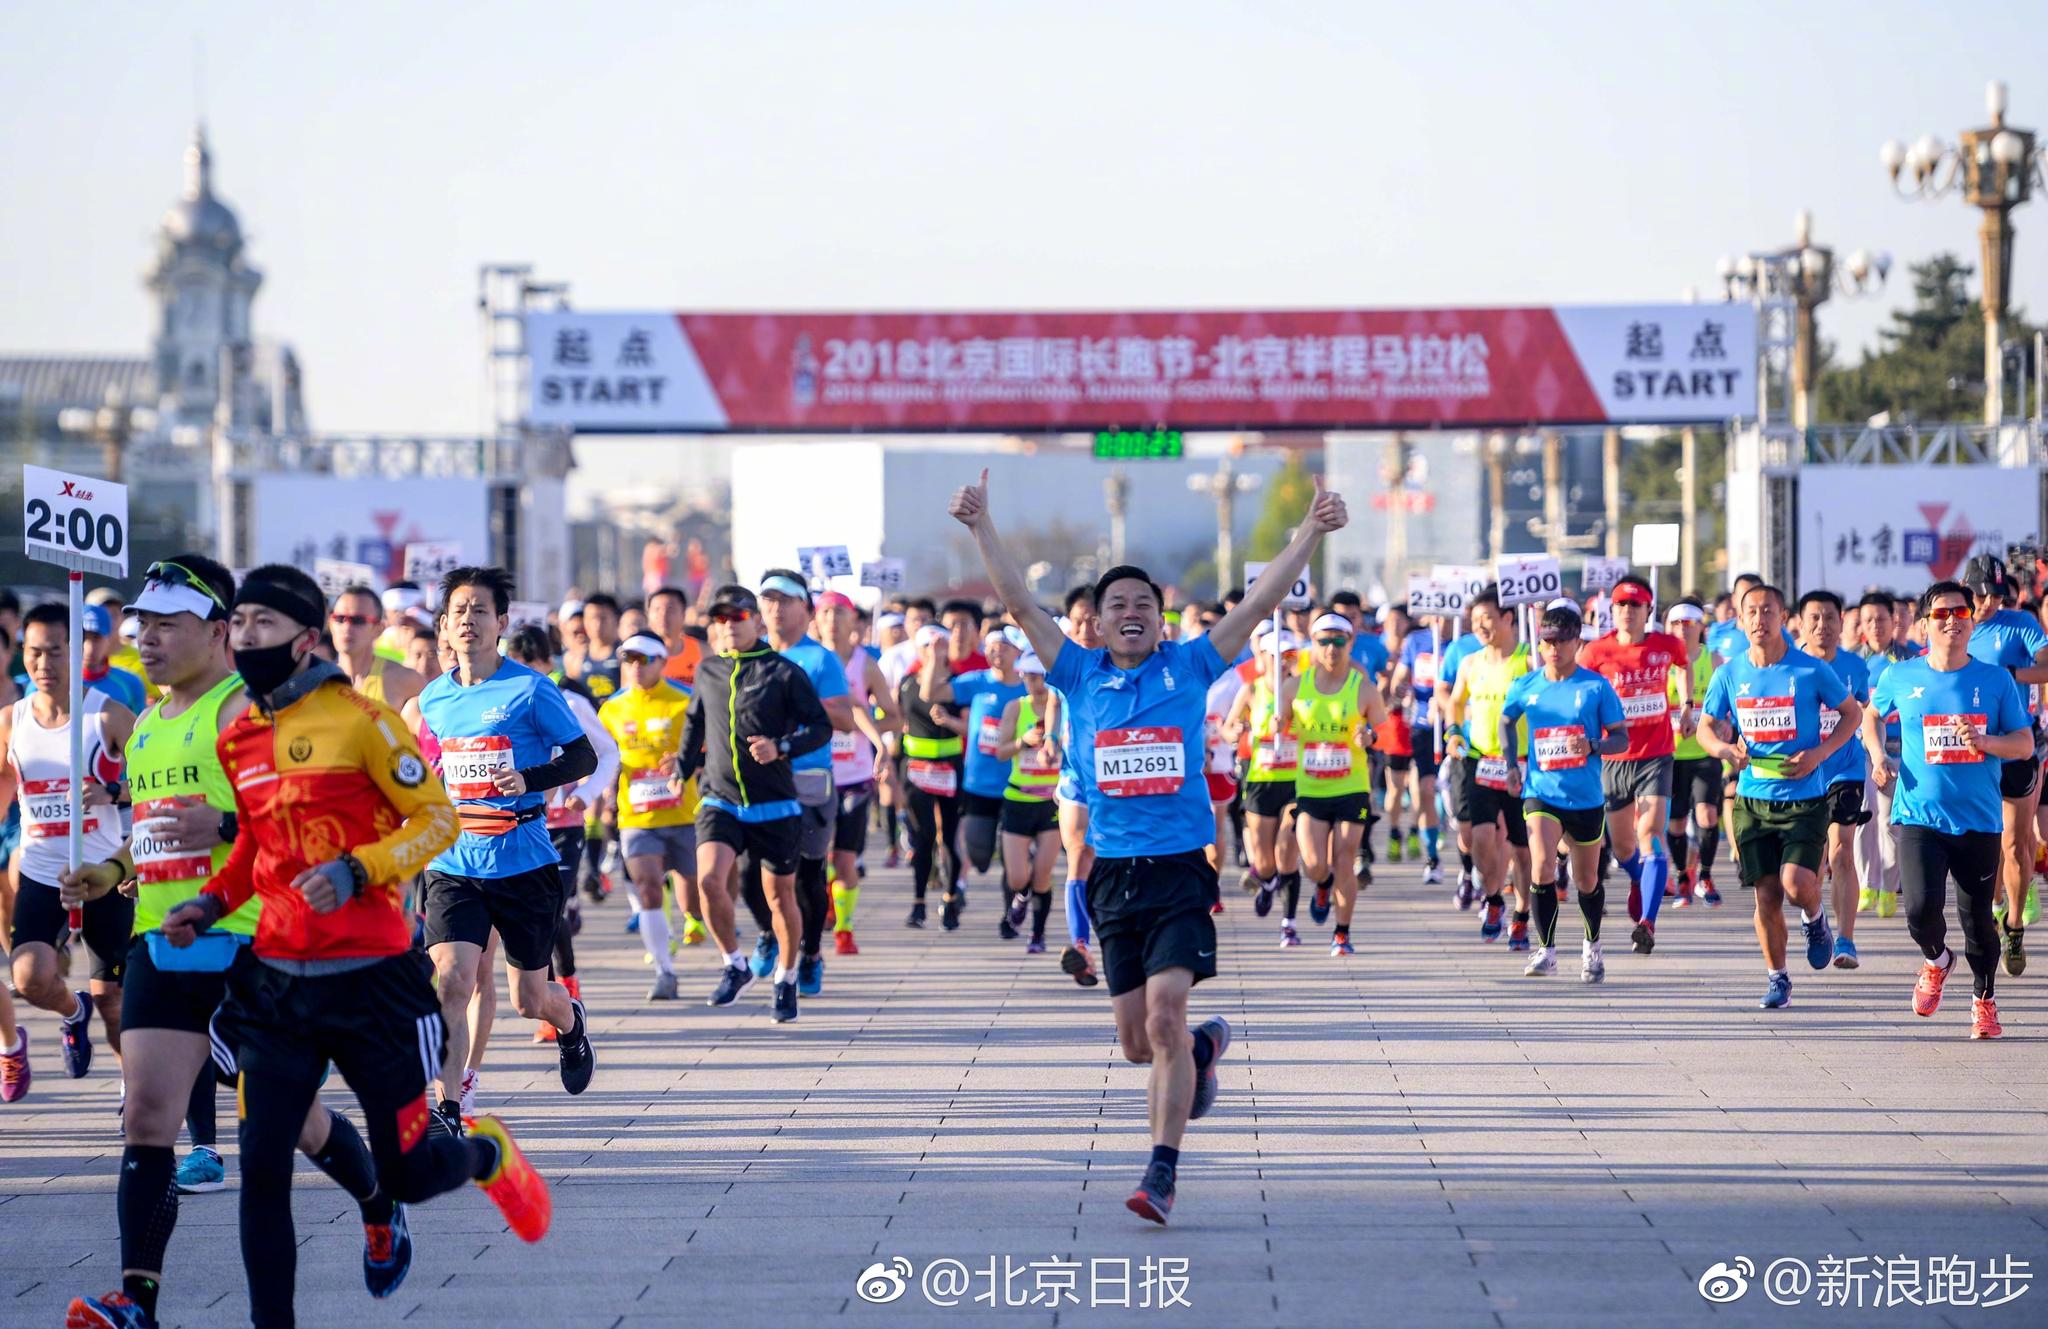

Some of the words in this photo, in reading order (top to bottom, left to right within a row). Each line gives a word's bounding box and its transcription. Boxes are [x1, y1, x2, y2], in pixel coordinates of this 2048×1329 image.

[541, 376, 667, 403] START
[1613, 369, 1741, 399] START
[26, 499, 122, 557] 2:00
[1501, 573, 1558, 597] 2:00
[1411, 591, 1461, 609] 2:30
[1742, 715, 1791, 728] M10418
[1103, 756, 1179, 776] M12691
